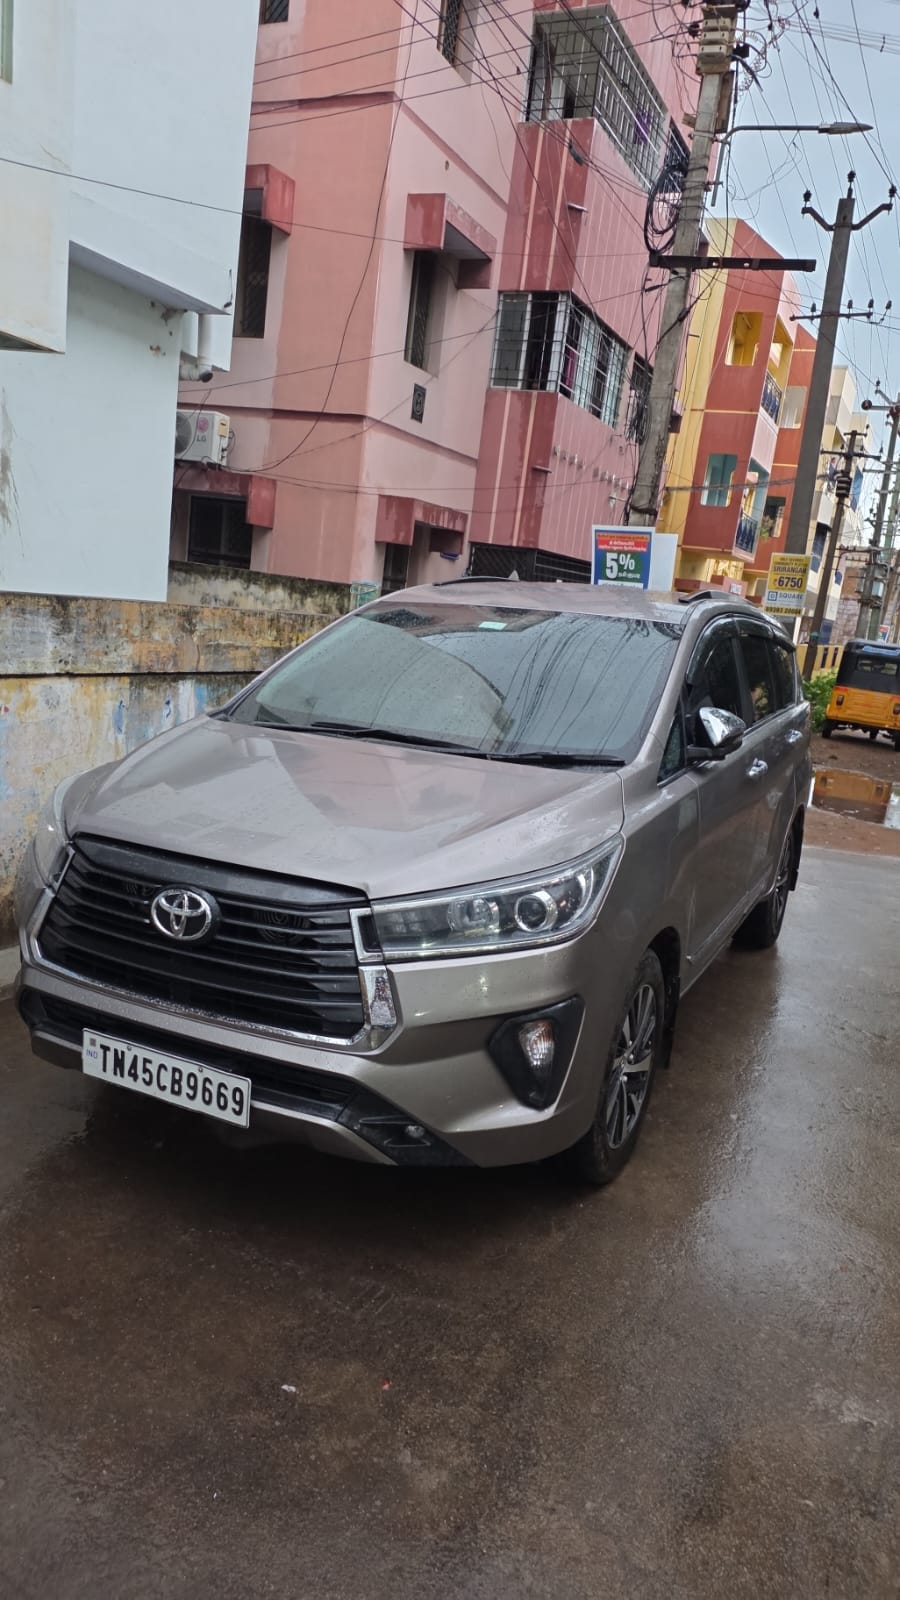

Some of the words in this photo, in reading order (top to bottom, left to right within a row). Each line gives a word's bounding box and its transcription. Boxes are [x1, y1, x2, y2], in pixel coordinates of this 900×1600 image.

[196, 434, 207, 442] LG
[605, 552, 635, 579] 5%
[100, 1044, 244, 1117] TN45CB9669
